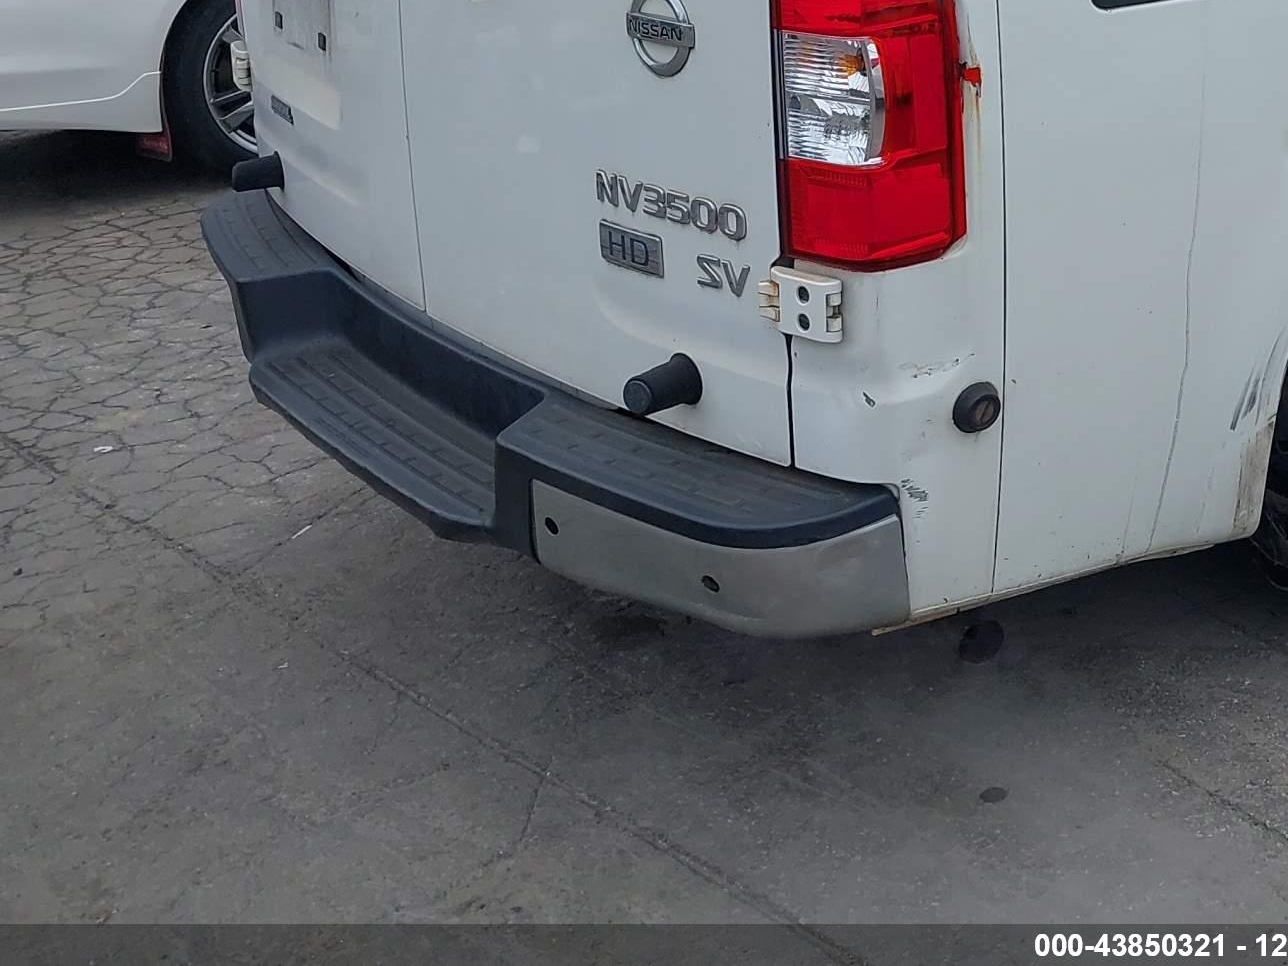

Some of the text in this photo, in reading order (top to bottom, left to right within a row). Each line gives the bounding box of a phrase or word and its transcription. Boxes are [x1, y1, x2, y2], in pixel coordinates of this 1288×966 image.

[627, 17, 682, 42] NISSAN
[596, 169, 748, 242] NV3500
[608, 231, 650, 267] HD
[696, 254, 751, 298] SV
